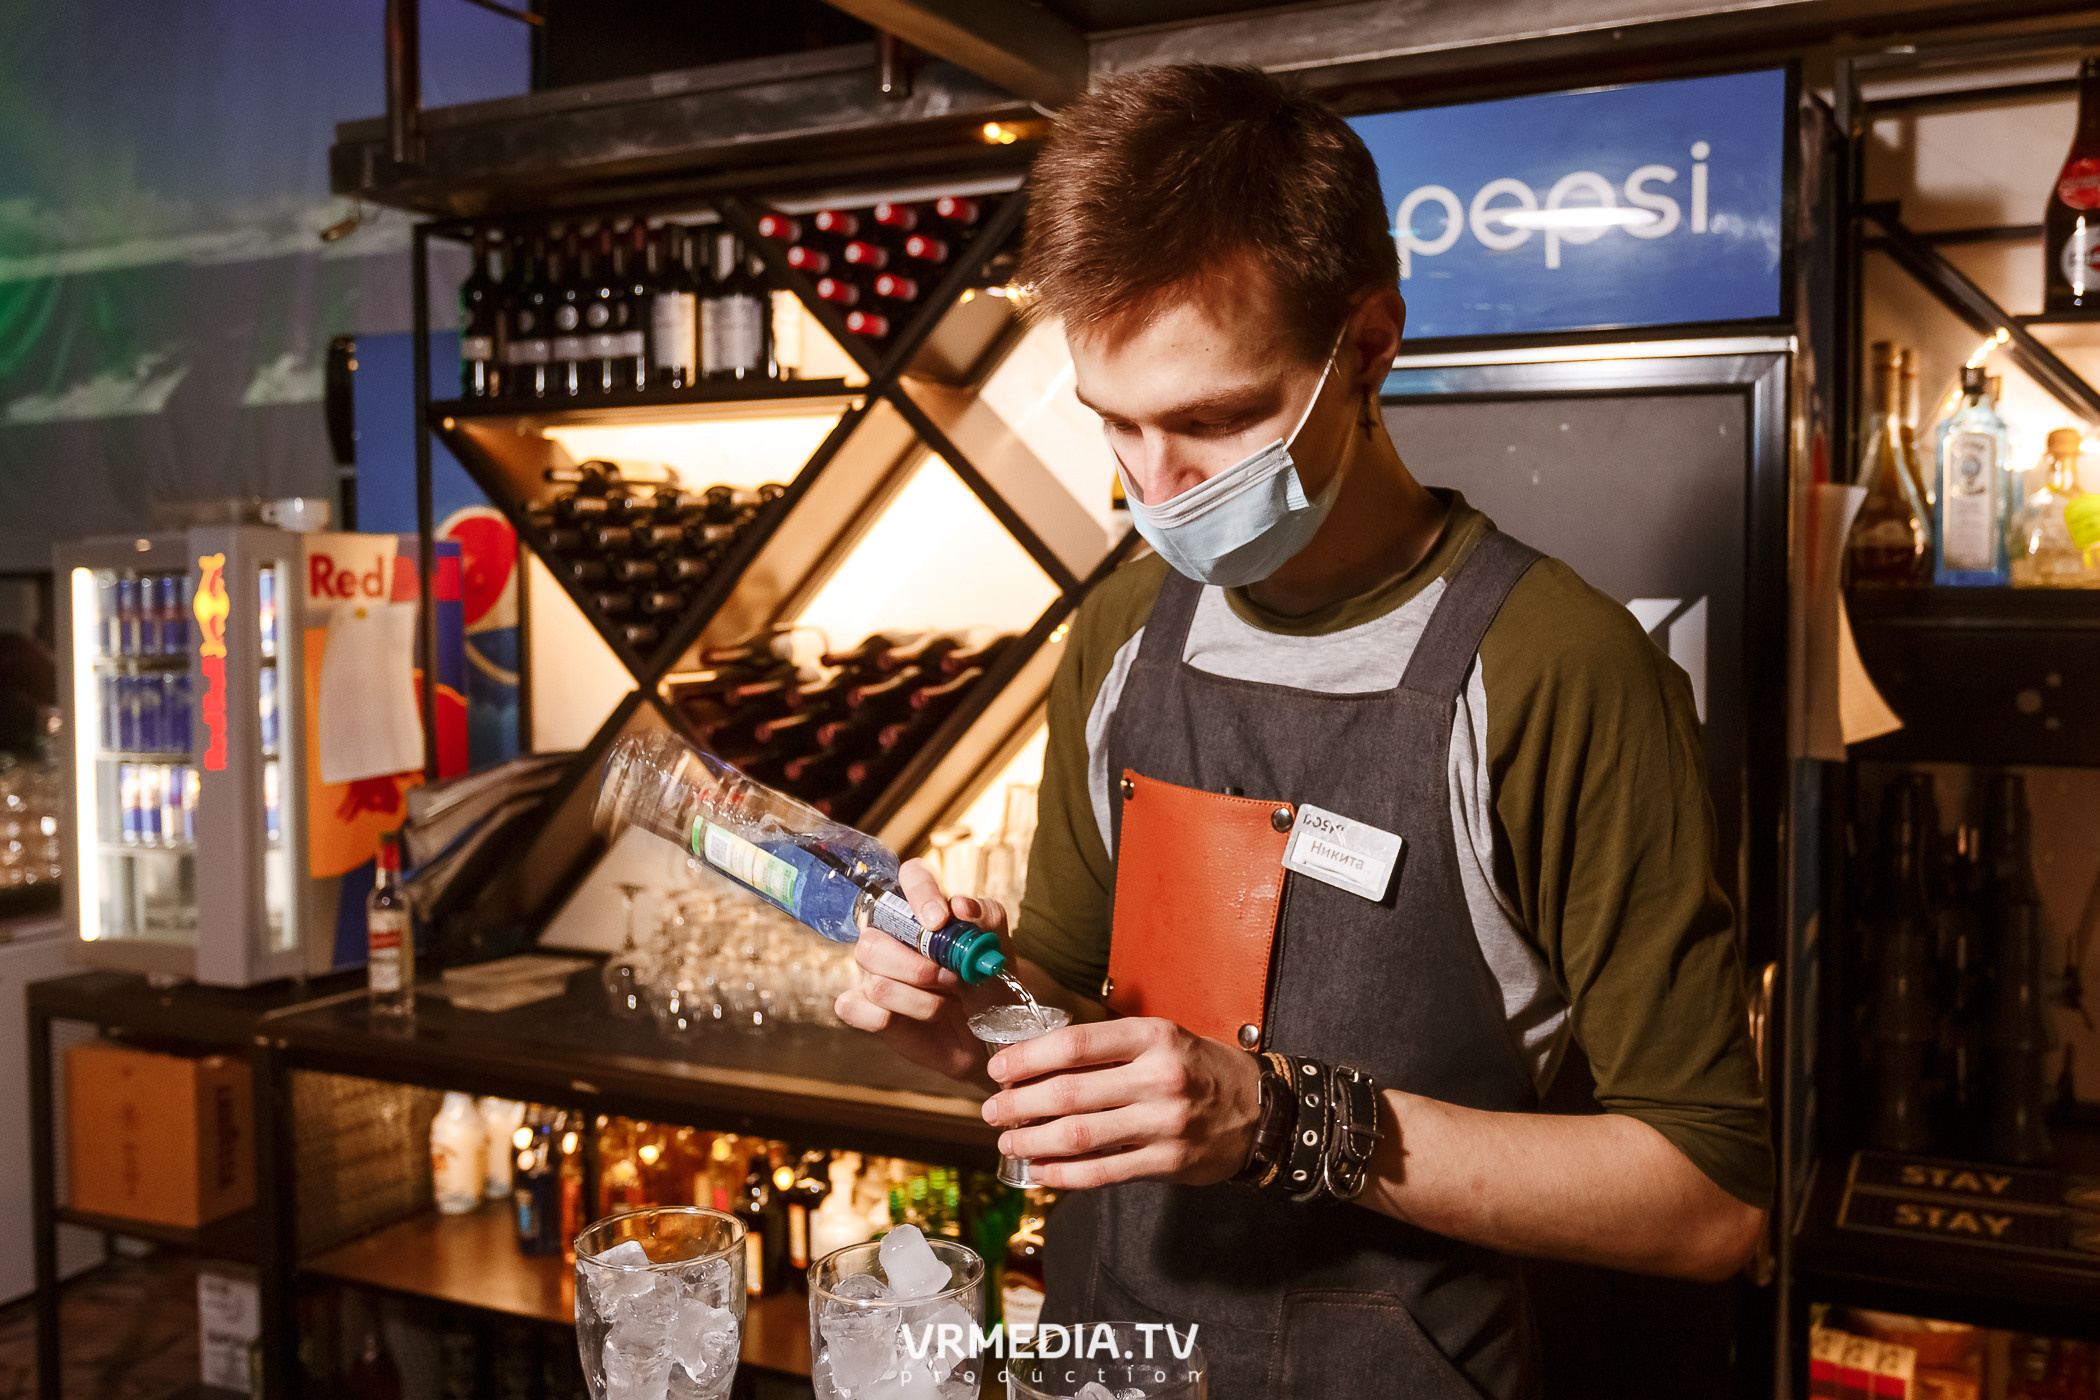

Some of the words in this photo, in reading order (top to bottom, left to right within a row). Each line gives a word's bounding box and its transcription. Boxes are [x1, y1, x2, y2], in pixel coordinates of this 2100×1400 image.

[1396, 141, 1710, 280] pepsi
[309, 553, 384, 598] Red
[1310, 841, 1364, 870] Никита
[1901, 1165, 2012, 1194] STAY
[1896, 1204, 2012, 1236] STAY
